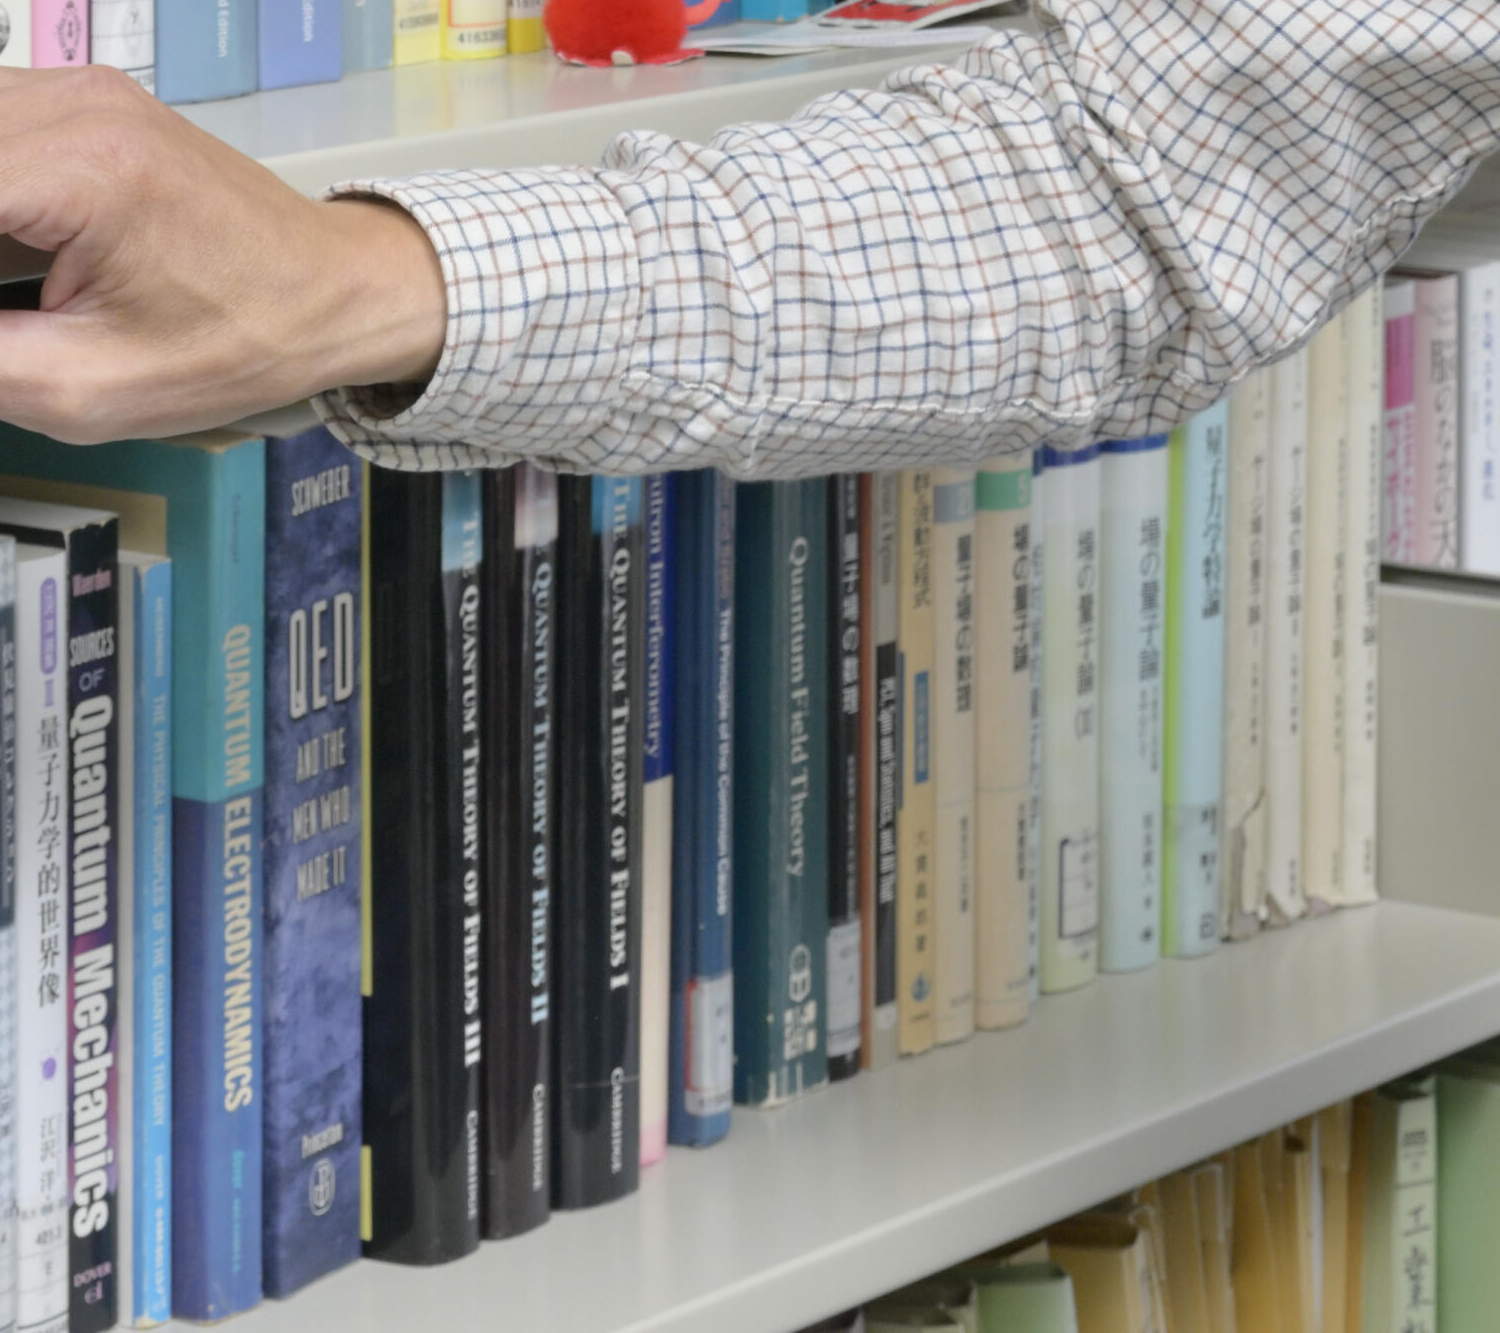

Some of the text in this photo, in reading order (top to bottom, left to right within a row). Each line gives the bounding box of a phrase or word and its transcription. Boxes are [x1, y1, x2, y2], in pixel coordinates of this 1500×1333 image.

[78, 668, 105, 693] OF
[288, 590, 354, 721] QED
[290, 464, 352, 517] SCHWEBER
[70, 694, 114, 1238] Quantum Mechanics
[221, 623, 253, 1113] QUANTUM ELECTRODYNAMICS
[459, 584, 481, 1068] QUANTUM THEORY OF FIELDS III
[609, 547, 631, 968] QUANTUM THEORY FIELDS
